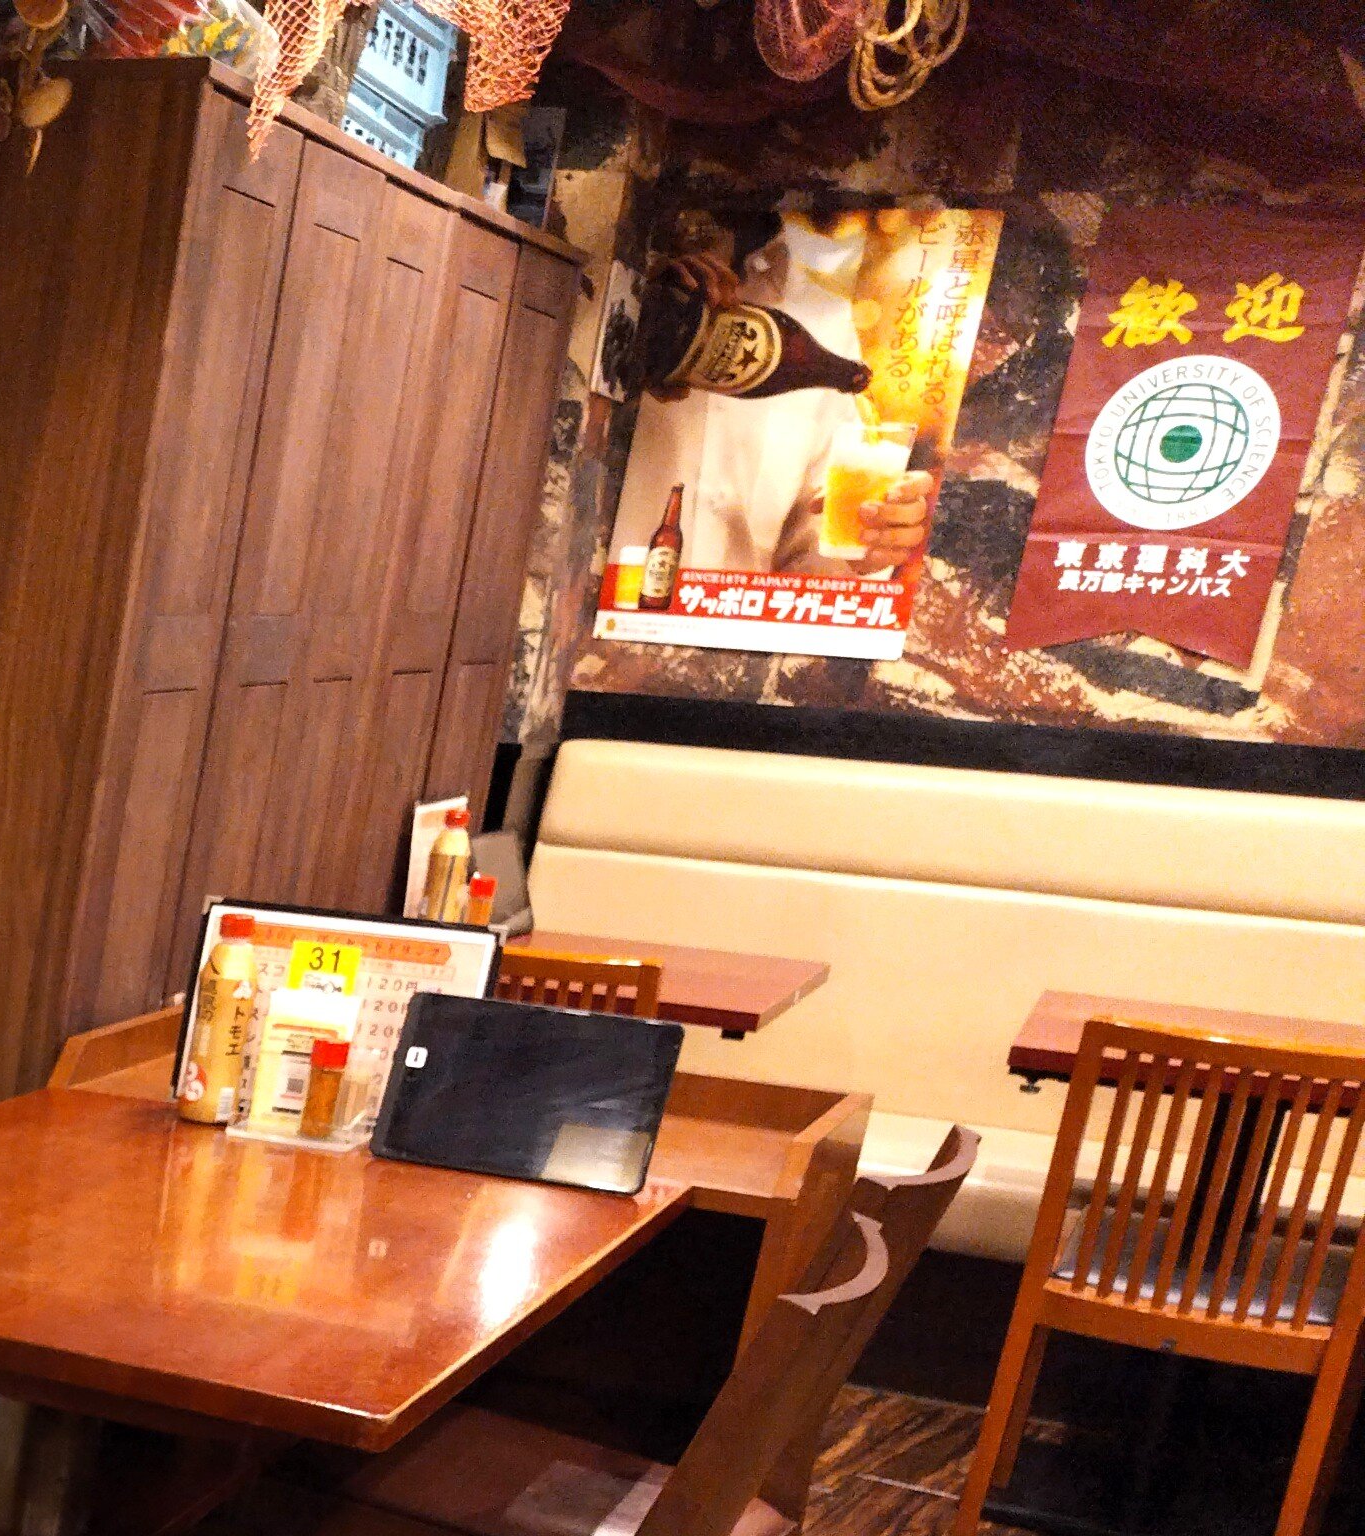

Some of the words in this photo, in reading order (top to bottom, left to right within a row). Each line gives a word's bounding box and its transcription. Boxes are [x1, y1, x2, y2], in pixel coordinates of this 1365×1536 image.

[886, 223, 946, 392] ビールがある。
[1111, 363, 1242, 417] UNIVERSITY
[1242, 386, 1266, 407] OF
[1093, 425, 1114, 491] TOKYO
[1221, 415, 1272, 501] SCIENCE
[1054, 540, 1250, 577] 東京理科大
[678, 585, 764, 616] サッポロ
[768, 590, 898, 627] ラガービール
[308, 946, 342, 973] 31
